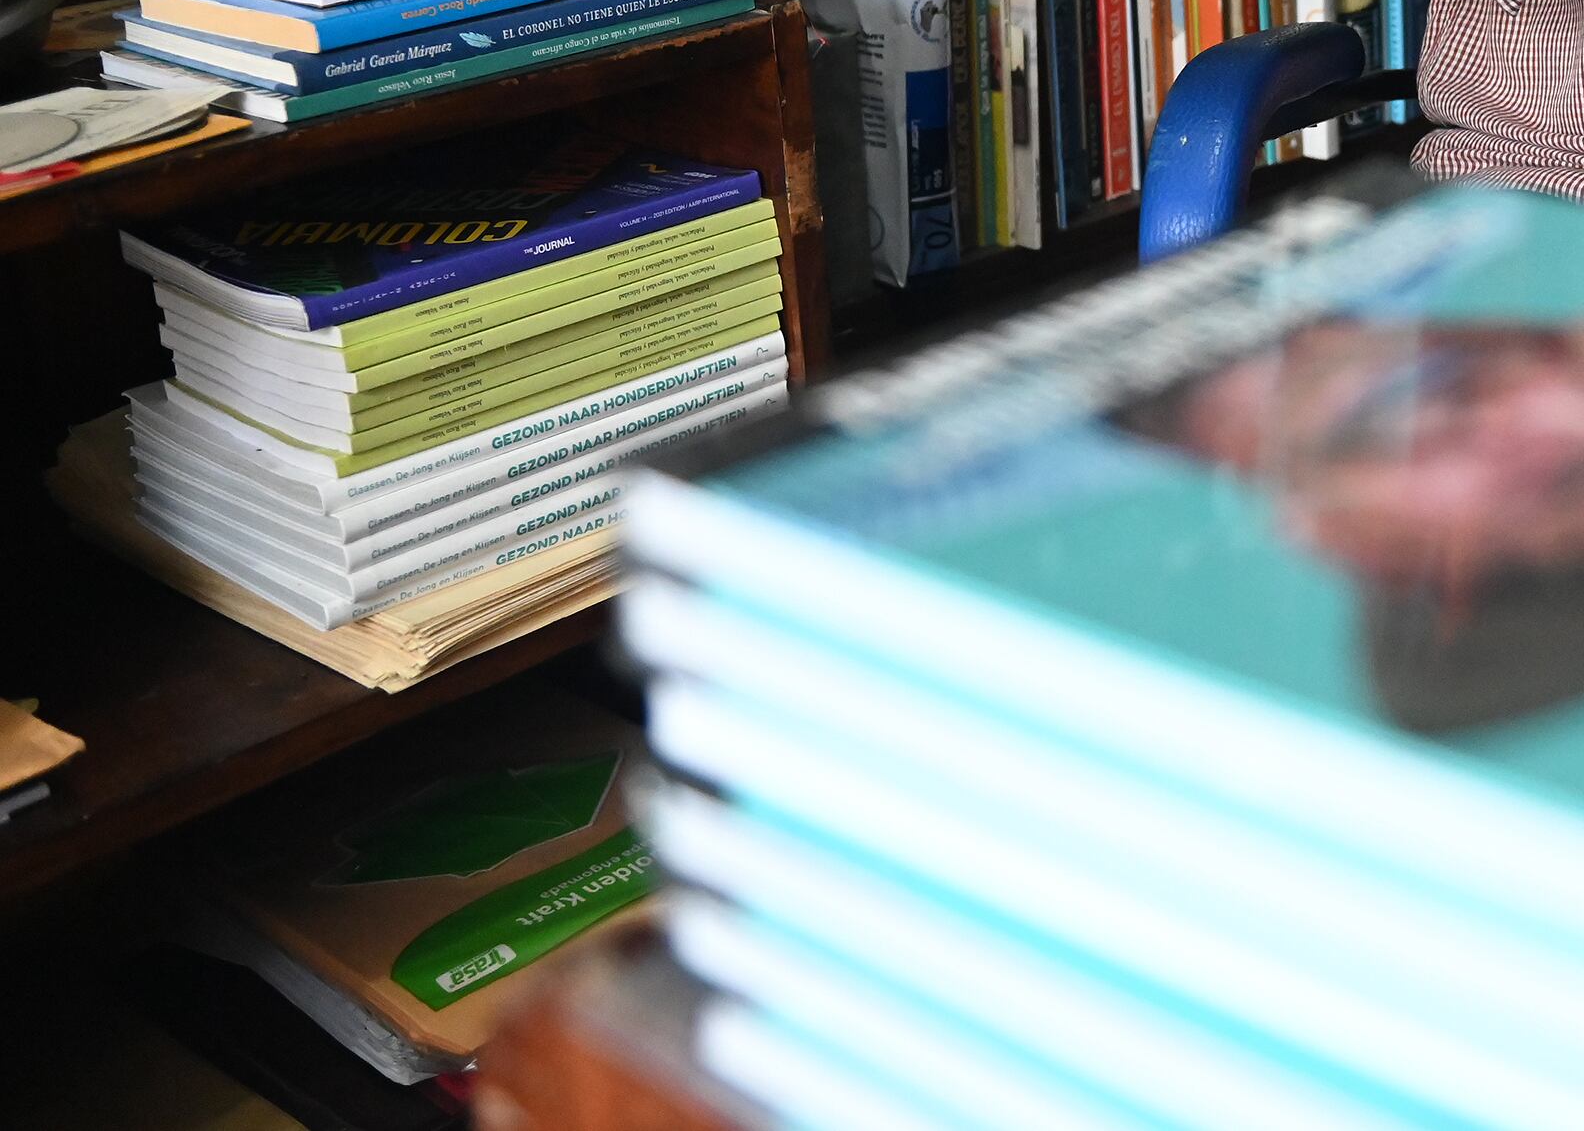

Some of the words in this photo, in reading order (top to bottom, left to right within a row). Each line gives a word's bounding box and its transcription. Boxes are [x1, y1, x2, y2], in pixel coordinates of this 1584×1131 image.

[401, 5, 437, 20] Correa
[439, 0, 465, 11] Roca
[502, 28, 516, 40] EL
[518, 18, 565, 37] CORONEL
[567, 13, 581, 25] NO
[583, 7, 613, 22] TIENE
[615, 0, 646, 15] QUIEN
[628, 26, 638, 34] de
[638, 16, 682, 33] Testimonios
[565, 37, 590, 50] Congo
[592, 34, 599, 44] el
[611, 28, 627, 39] vida
[325, 57, 365, 78] Gabriel
[407, 42, 452, 61] Márquez
[532, 43, 564, 57] africano
[378, 81, 411, 94] Velasco
[412, 74, 433, 86] Rico
[619, 217, 641, 229] VOLUME
[653, 210, 665, 219] 2021
[665, 203, 686, 216] EDITION
[688, 199, 701, 209] AARP
[701, 189, 741, 205] INTERNATIONAL
[236, 219, 529, 246] COLOMBIA
[533, 236, 575, 255] JOURNAL
[606, 249, 630, 261] felicidad
[439, 302, 453, 310] Rico
[618, 289, 642, 301] felicidad
[415, 308, 438, 317] Velasco
[430, 350, 452, 360] Velasco
[492, 418, 555, 450] GEZOND
[558, 403, 600, 427] NAAR
[603, 355, 738, 411] HONDERDVIJFTIEN
[507, 447, 569, 479] GEZOND
[572, 430, 612, 455] NAAR
[615, 381, 745, 439] HONDERDVIJFTIEN
[511, 474, 572, 507] GEZOND
[575, 458, 615, 482] NAAR
[618, 407, 747, 466] HONDERDVIJFTIEN
[348, 477, 394, 498] Claassen,
[396, 471, 409, 481] De
[411, 462, 433, 476] Jong
[435, 458, 447, 468] en
[449, 446, 481, 463] Klijsen
[368, 508, 411, 530] Claassen,
[415, 502, 426, 512] De
[427, 493, 450, 506] Jong
[453, 489, 464, 498] en
[466, 477, 497, 492] Klijsen
[516, 504, 578, 536] GEZOND
[581, 486, 621, 511] NAAR
[371, 538, 416, 559] Claassen,
[418, 532, 430, 541] De
[434, 522, 454, 536] Jong
[456, 518, 468, 527] en
[469, 505, 501, 522] Klijsen
[495, 534, 559, 566] GEZOND
[562, 517, 604, 542] NAAR
[377, 569, 423, 589] Claassen,
[424, 561, 436, 571] De
[437, 552, 459, 565] Jong
[462, 548, 473, 557] en
[474, 534, 505, 551] Klijsen
[540, 856, 621, 898] engomada
[582, 856, 653, 893] olden
[516, 891, 587, 926] Kraft
